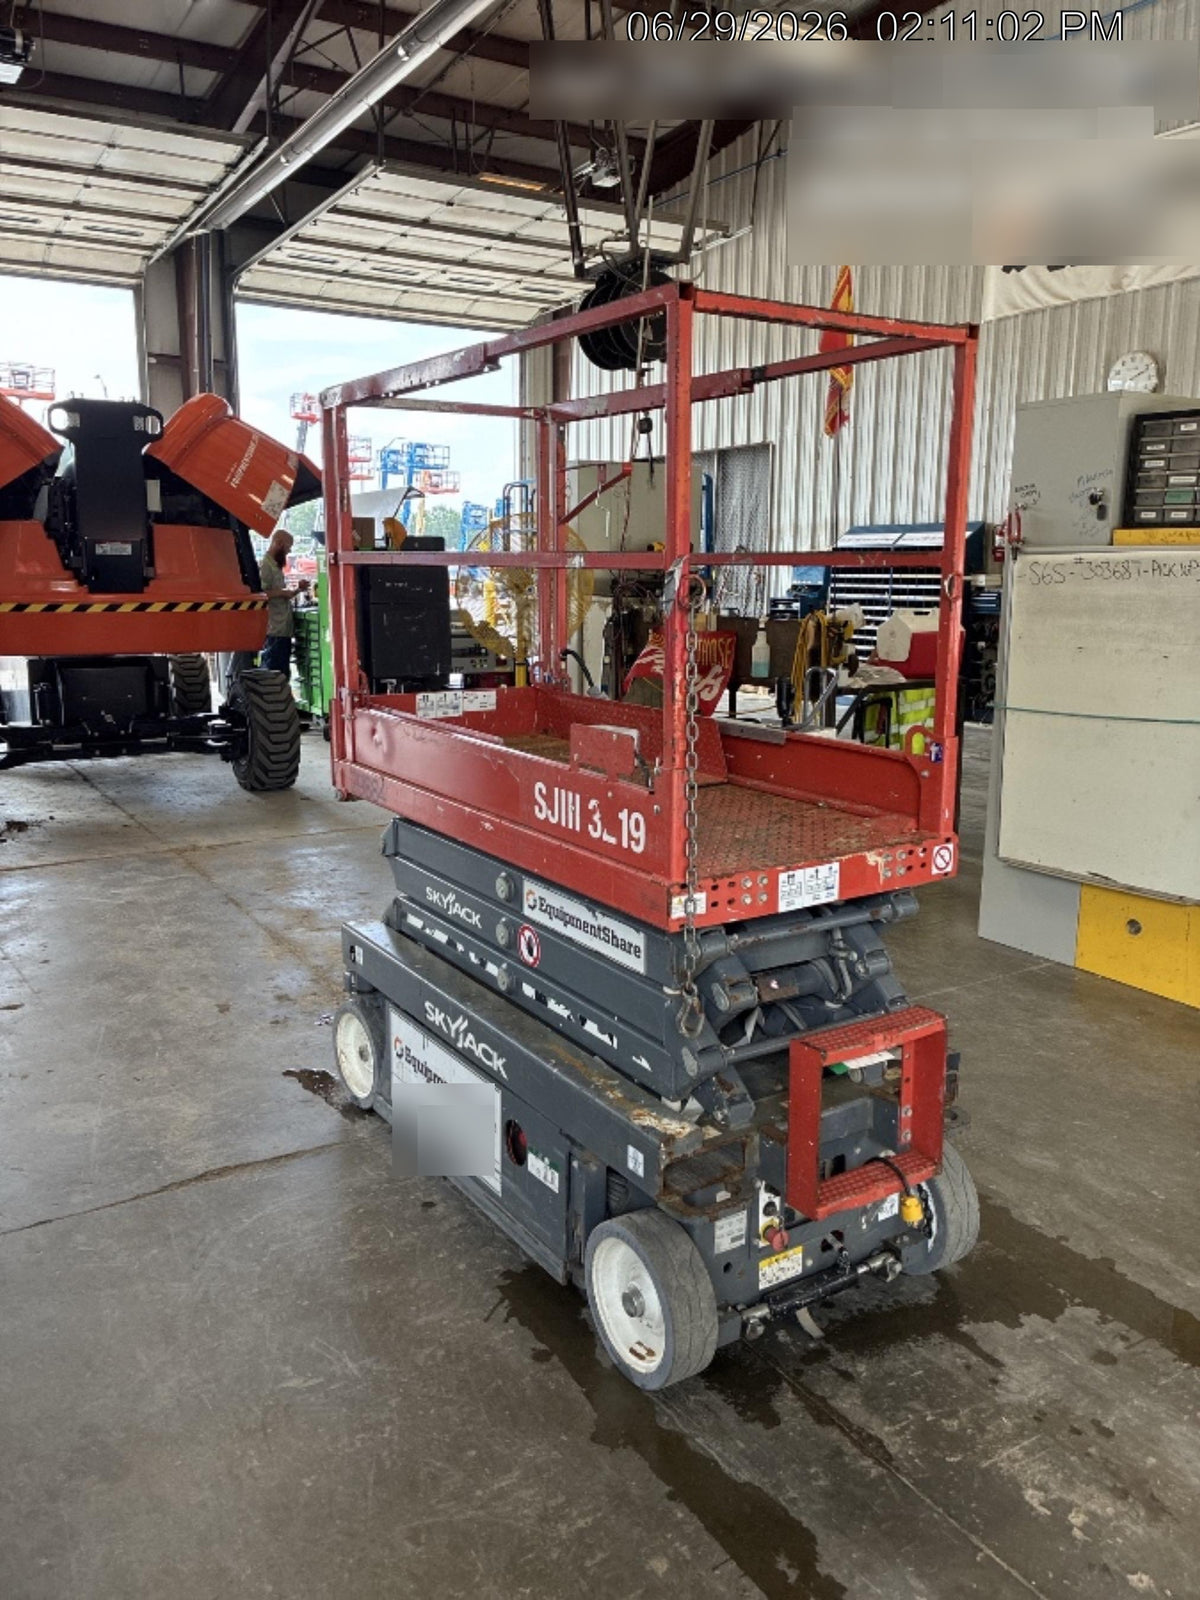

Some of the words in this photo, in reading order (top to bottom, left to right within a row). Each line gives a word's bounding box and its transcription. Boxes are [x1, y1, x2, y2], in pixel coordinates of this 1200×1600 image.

[425, 886, 482, 929] SKYJACK
[538, 895, 641, 959] EquipmentShare
[424, 1000, 509, 1081] SKYJACK
